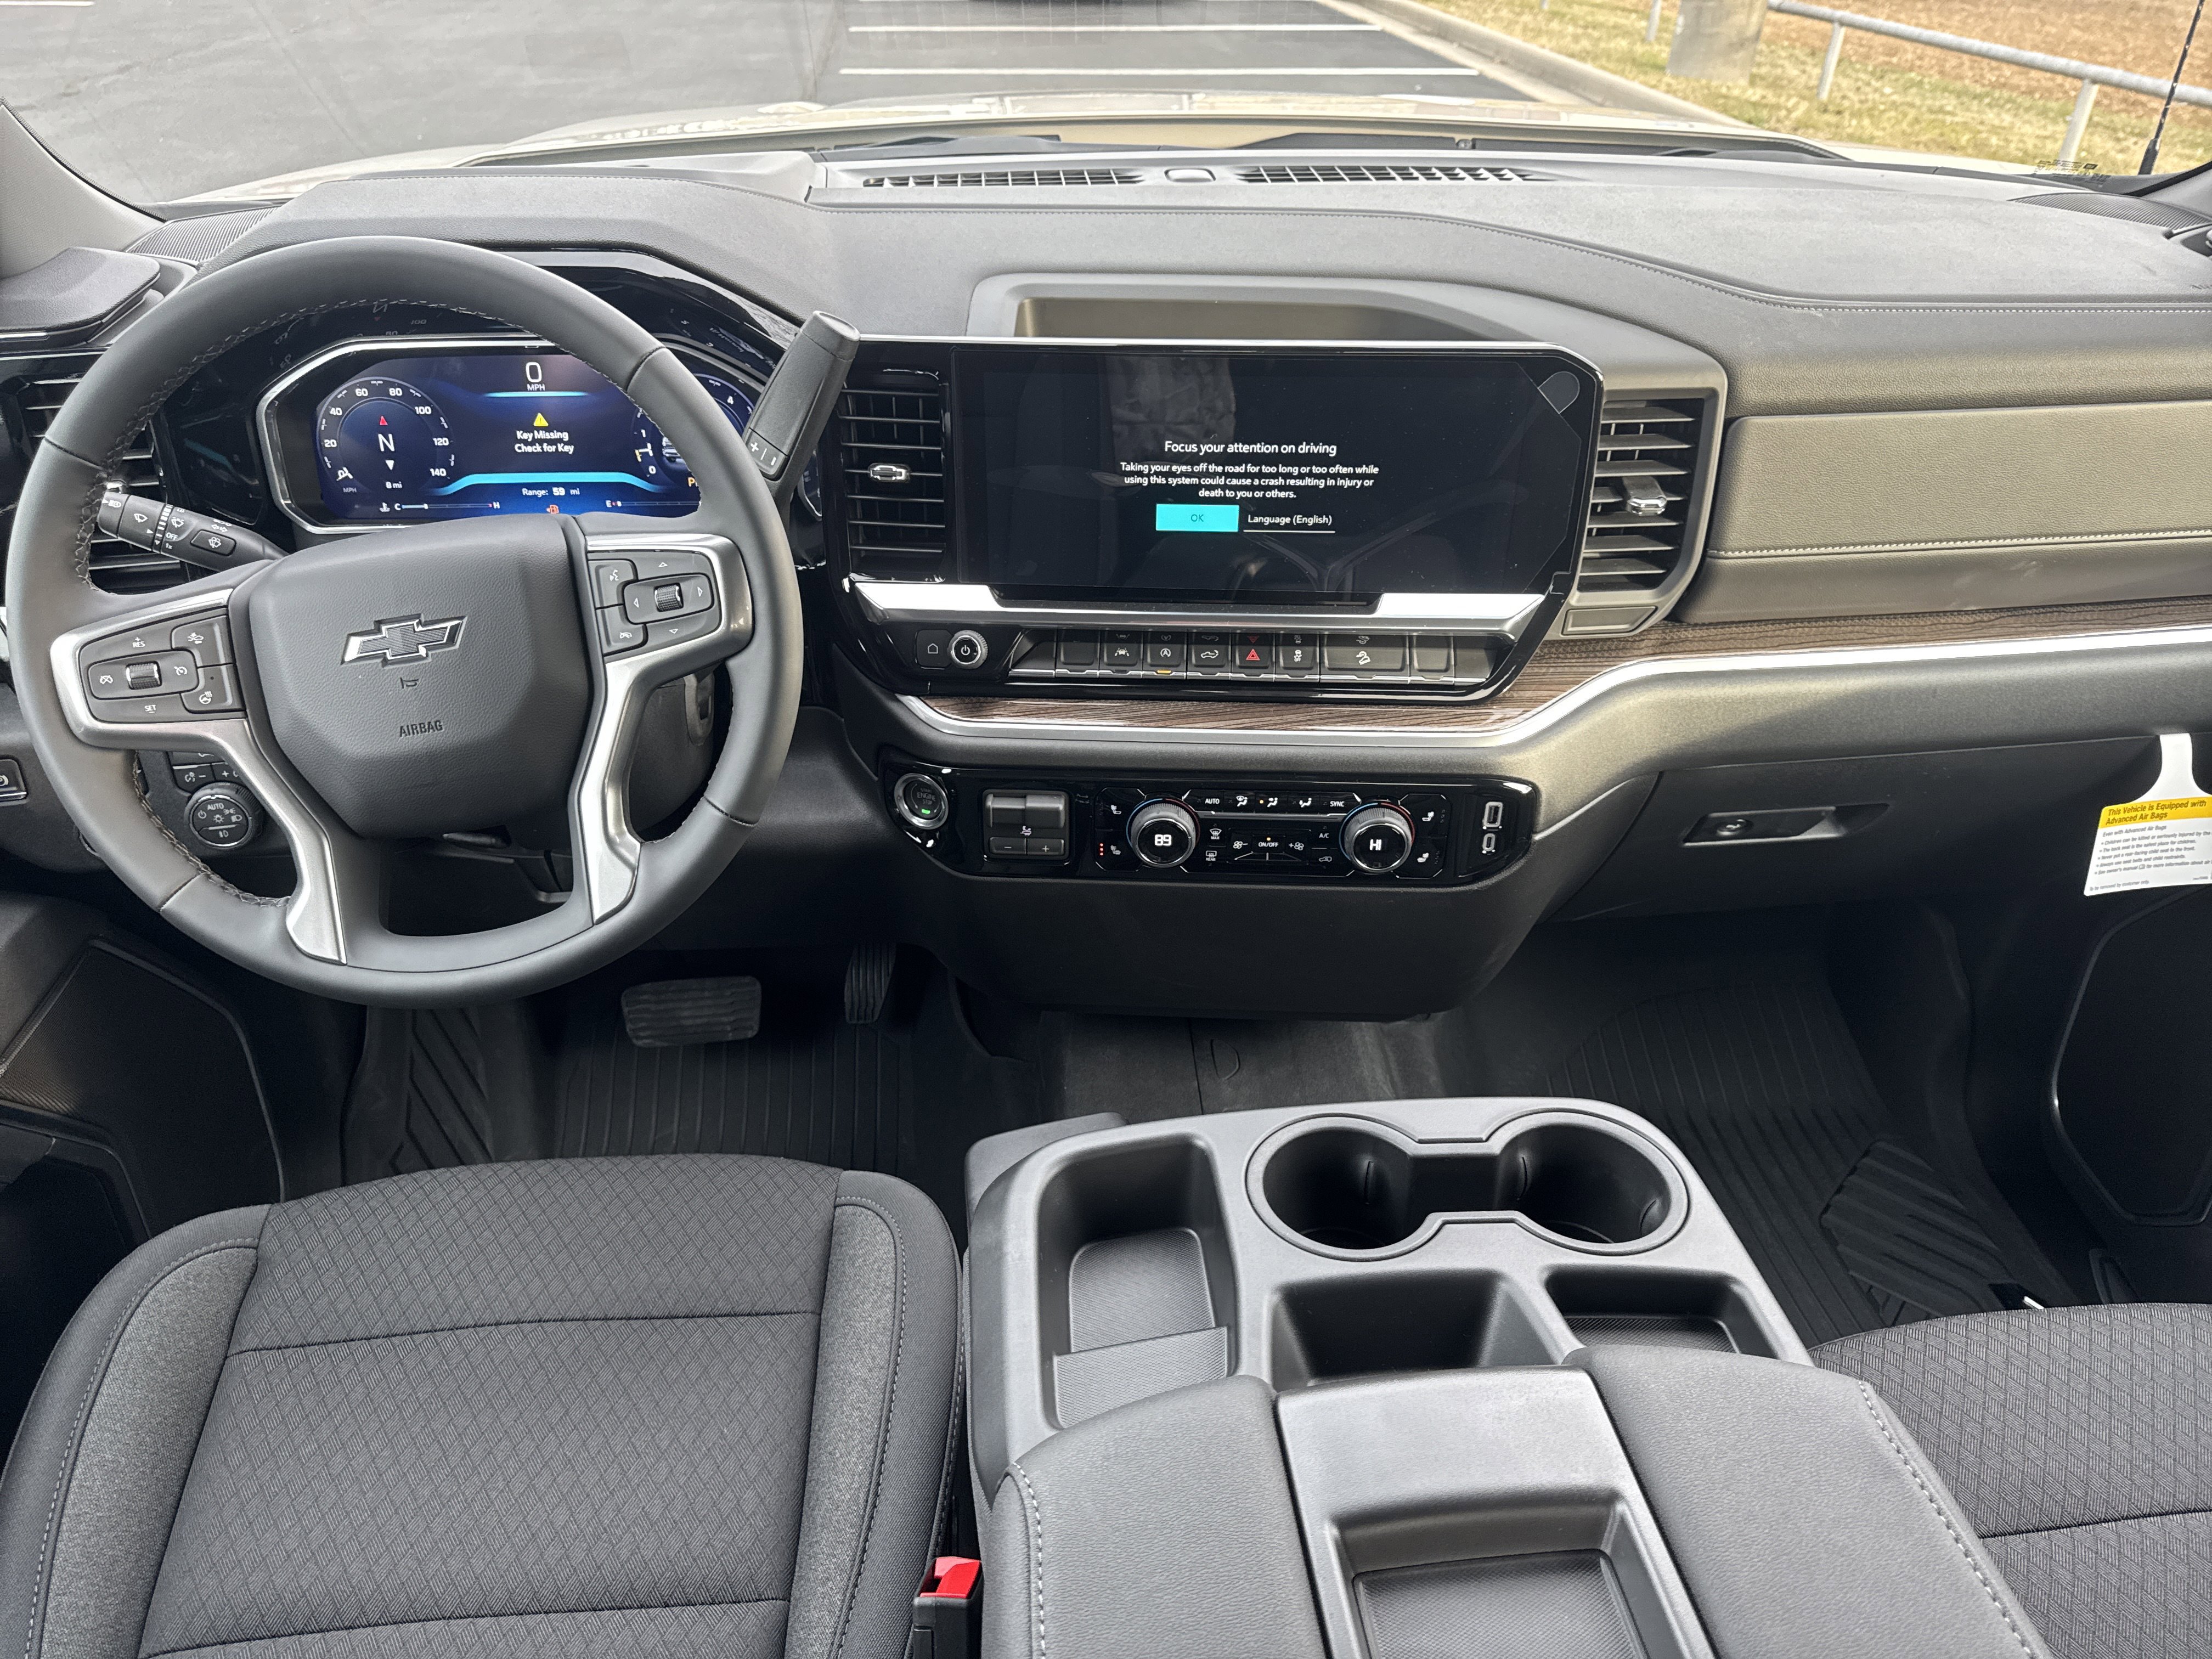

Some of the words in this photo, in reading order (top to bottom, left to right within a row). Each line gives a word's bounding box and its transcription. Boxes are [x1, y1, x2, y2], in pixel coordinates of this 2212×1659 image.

[526, 362, 542, 382] 0
[355, 388, 368, 396] 60
[389, 388, 402, 396] 80
[727, 396, 734, 404] 4
[330, 408, 342, 416] 40
[414, 406, 432, 415] 100
[516, 430, 533, 442] Key
[534, 430, 569, 441] Missing
[641, 429, 646, 438] 1
[377, 433, 395, 452] N
[432, 437, 449, 446] 120
[515, 443, 543, 453] Check
[543, 443, 556, 452] for
[557, 443, 574, 454] Key
[1165, 441, 1198, 452] Focus
[1199, 444, 1225, 455] your
[1227, 442, 1278, 453] attention
[1281, 444, 1295, 453] on
[1298, 442, 1337, 457] driving
[430, 468, 447, 477] 140
[648, 465, 656, 474] 0
[1120, 462, 1149, 473] Taking
[1150, 465, 1170, 473] your
[1172, 465, 1192, 473] eyes
[1193, 463, 1207, 472] off
[1208, 464, 1222, 472] the
[1224, 464, 1245, 472] road
[1246, 464, 1260, 473] for
[1261, 465, 1277, 473] too
[1279, 464, 1299, 475] long
[1312, 465, 1328, 473] too
[1329, 464, 1353, 473] often
[1355, 465, 1379, 474] while
[1125, 476, 1148, 486] using
[1150, 475, 1166, 484] this
[1167, 477, 1199, 486] system
[1200, 476, 1224, 485] could
[1260, 477, 1284, 486] crash
[1286, 477, 1325, 488] resulting
[1327, 477, 1335, 486] in
[1337, 477, 1362, 488] injury
[522, 488, 549, 498] Range:
[1198, 488, 1224, 497] death
[1235, 490, 1252, 499] you
[1265, 489, 1296, 498] others.
[1190, 514, 1204, 522] OK
[1248, 515, 1290, 526] Language
[1293, 515, 1333, 526] (English)
[166, 532, 178, 540] OFF
[399, 719, 443, 738] AIRBAG
[2123, 805, 2147, 814] Vehicle
[2156, 801, 2189, 810] Equipped
[2106, 814, 2138, 825] Advanced
[2150, 811, 2168, 820] Bags
[1154, 834, 1172, 846] 89
[1369, 839, 1382, 851] HI
